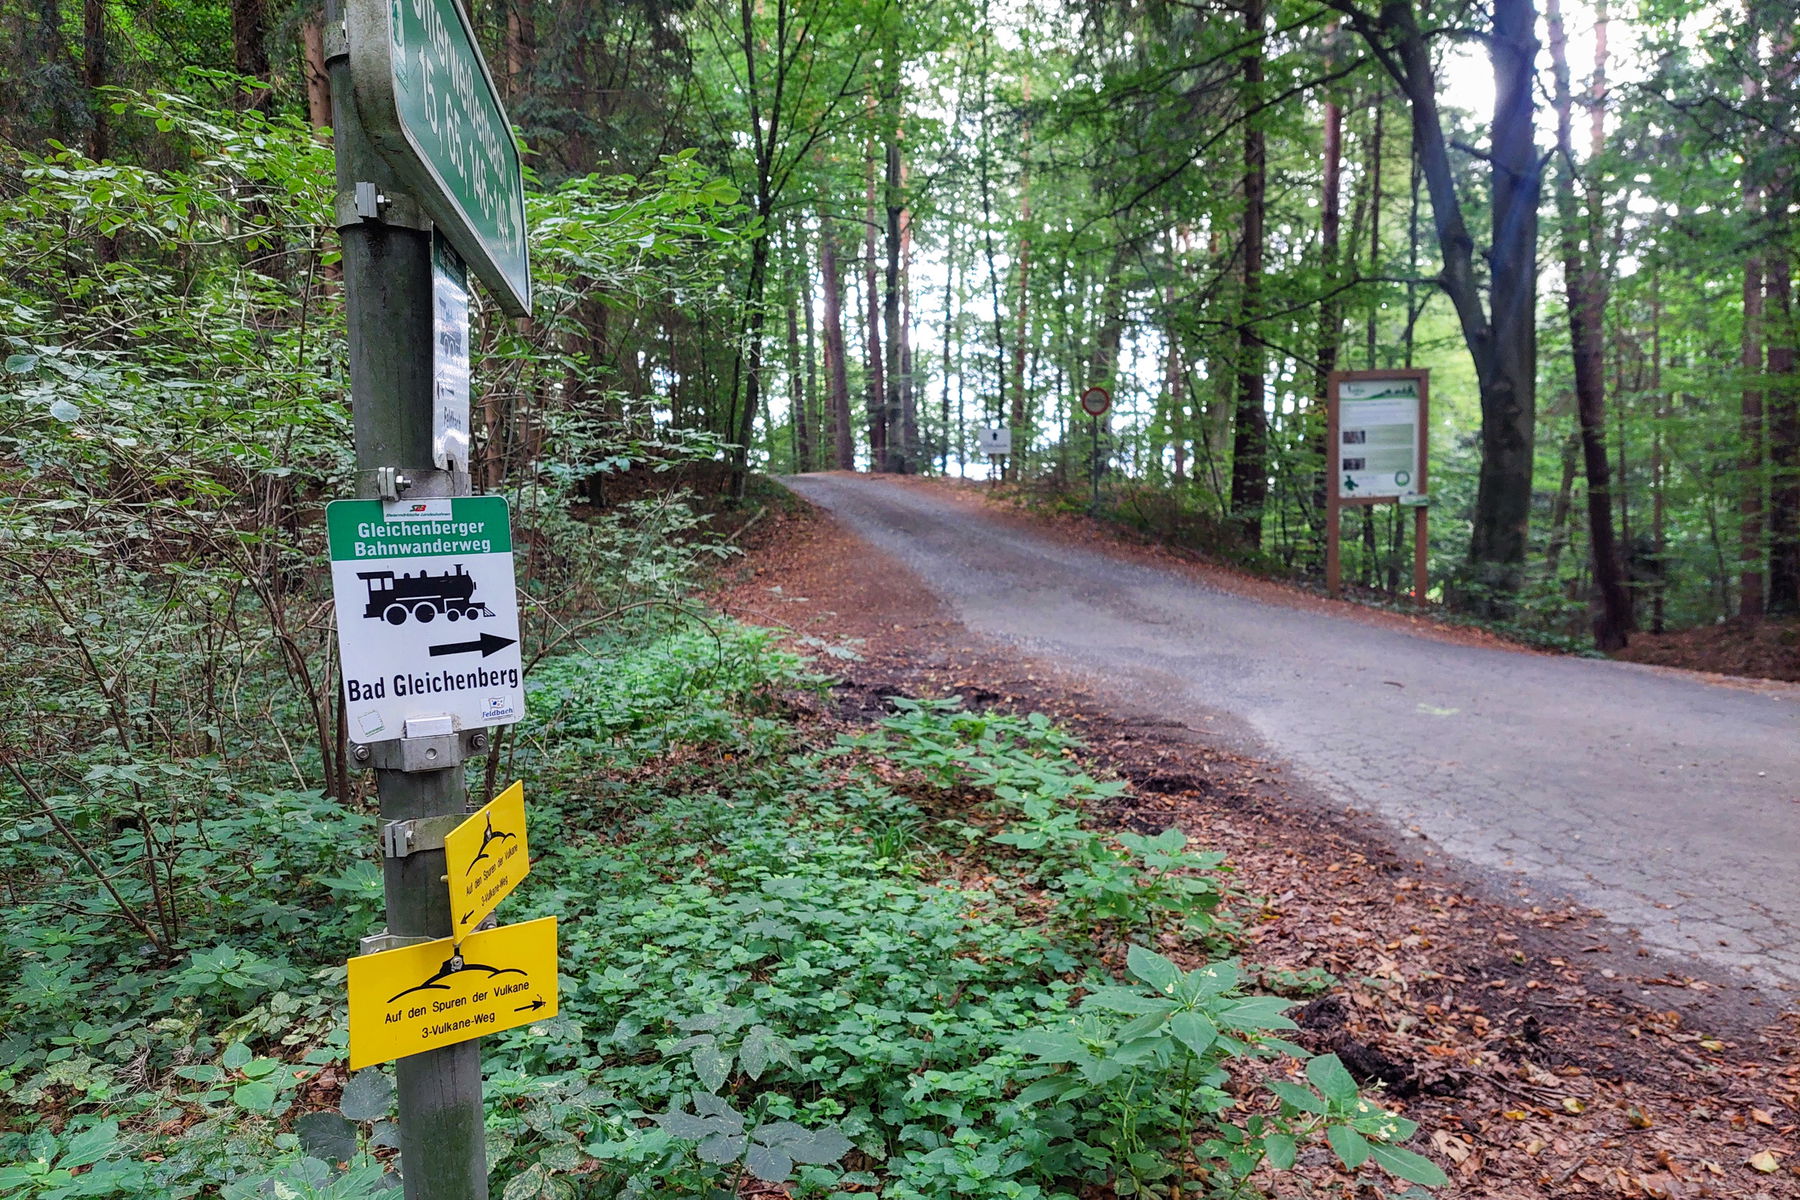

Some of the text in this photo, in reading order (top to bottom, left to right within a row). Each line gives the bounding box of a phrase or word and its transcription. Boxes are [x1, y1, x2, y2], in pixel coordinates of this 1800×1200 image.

[419, 45, 443, 157] 15,
[446, 92, 468, 198] 65,
[358, 521, 485, 538] Gleichenberger
[354, 538, 491, 557] Bahnwanderweg
[347, 667, 518, 702] Bad Gleichenberg
[482, 707, 514, 718] Feldbach
[384, 981, 530, 1025] Auf den Spuren der Vulkane
[421, 1012, 496, 1039] 3-Vulkane-Weg
